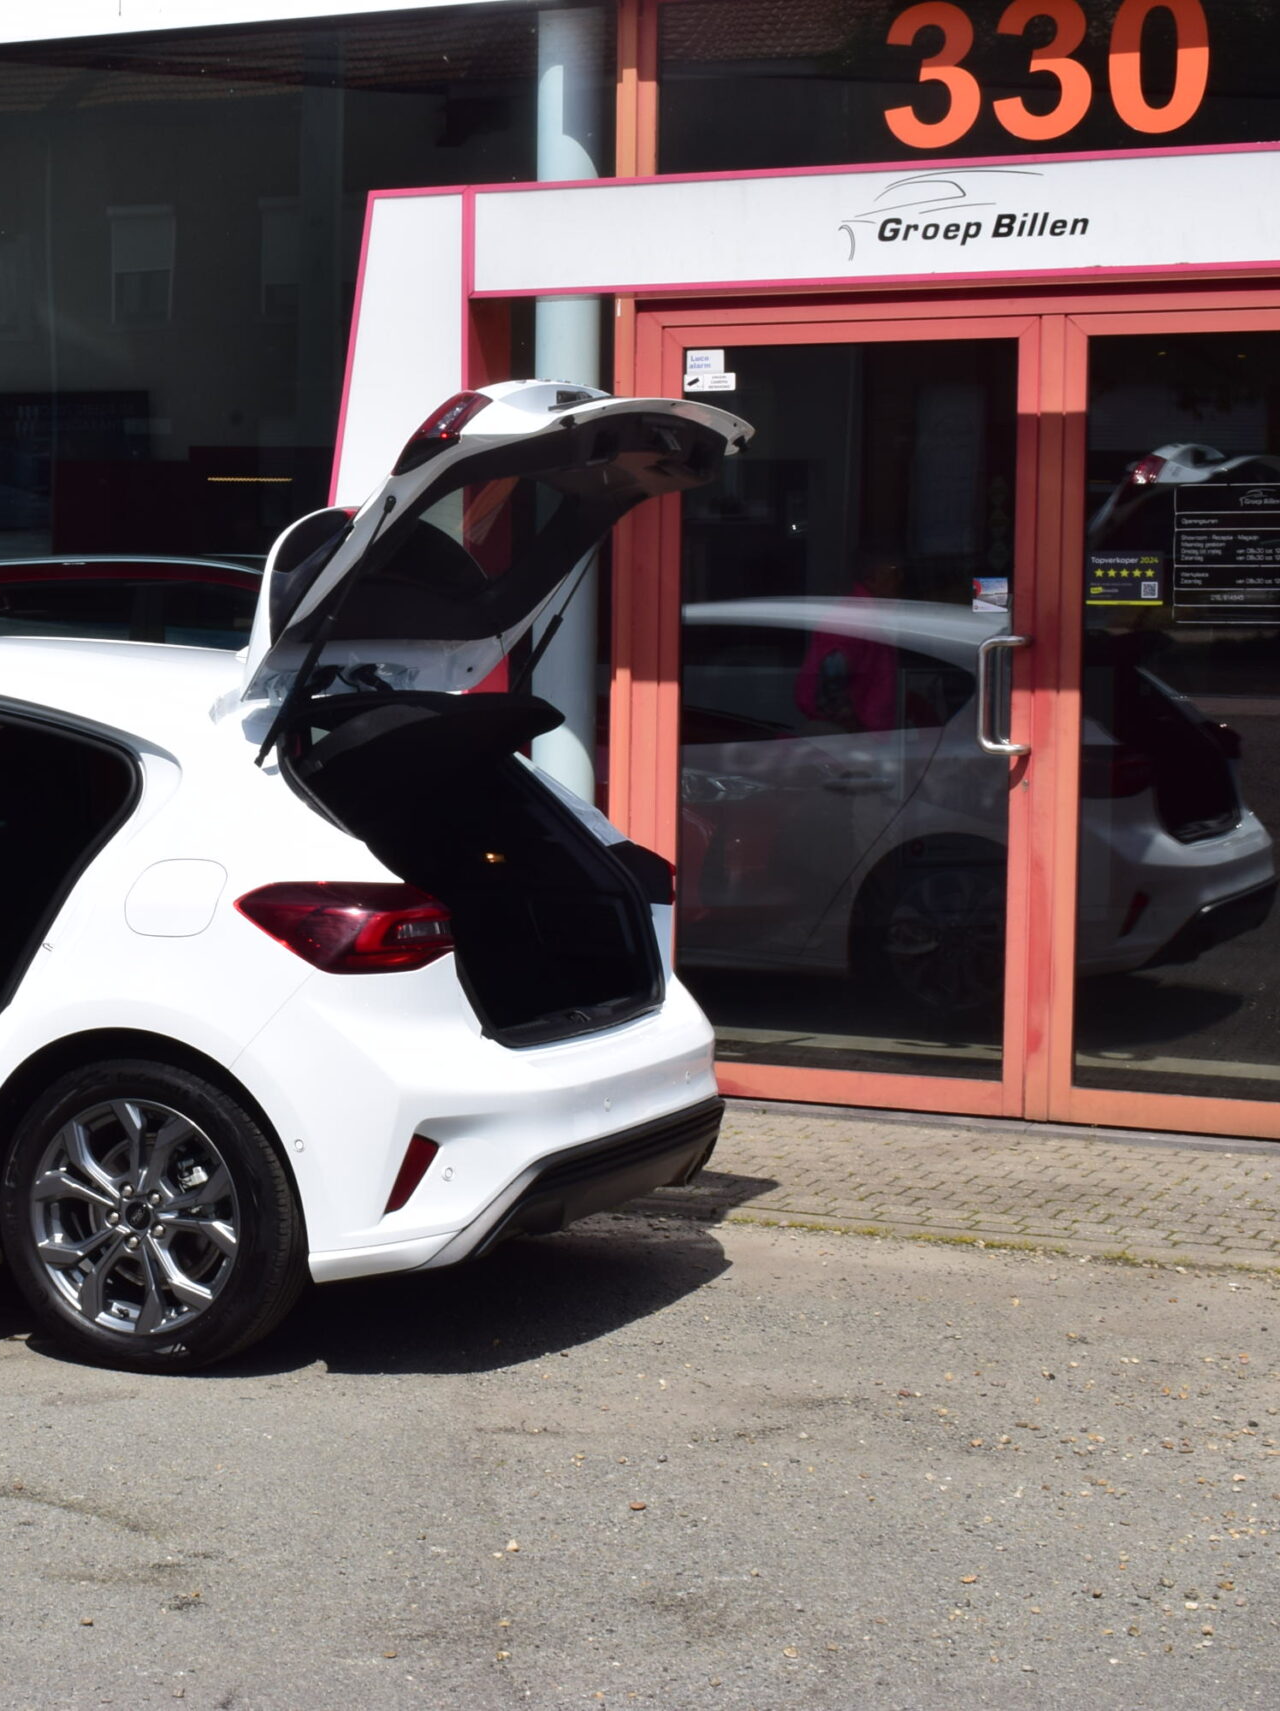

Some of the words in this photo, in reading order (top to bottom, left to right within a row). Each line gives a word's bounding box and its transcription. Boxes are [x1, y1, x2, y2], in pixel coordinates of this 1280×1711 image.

[884, 0, 1209, 148] 330
[877, 217, 982, 246] Groep
[991, 212, 1089, 238] Billen
[1091, 556, 1138, 565] Topverkoper
[1140, 556, 1159, 564] 2024
